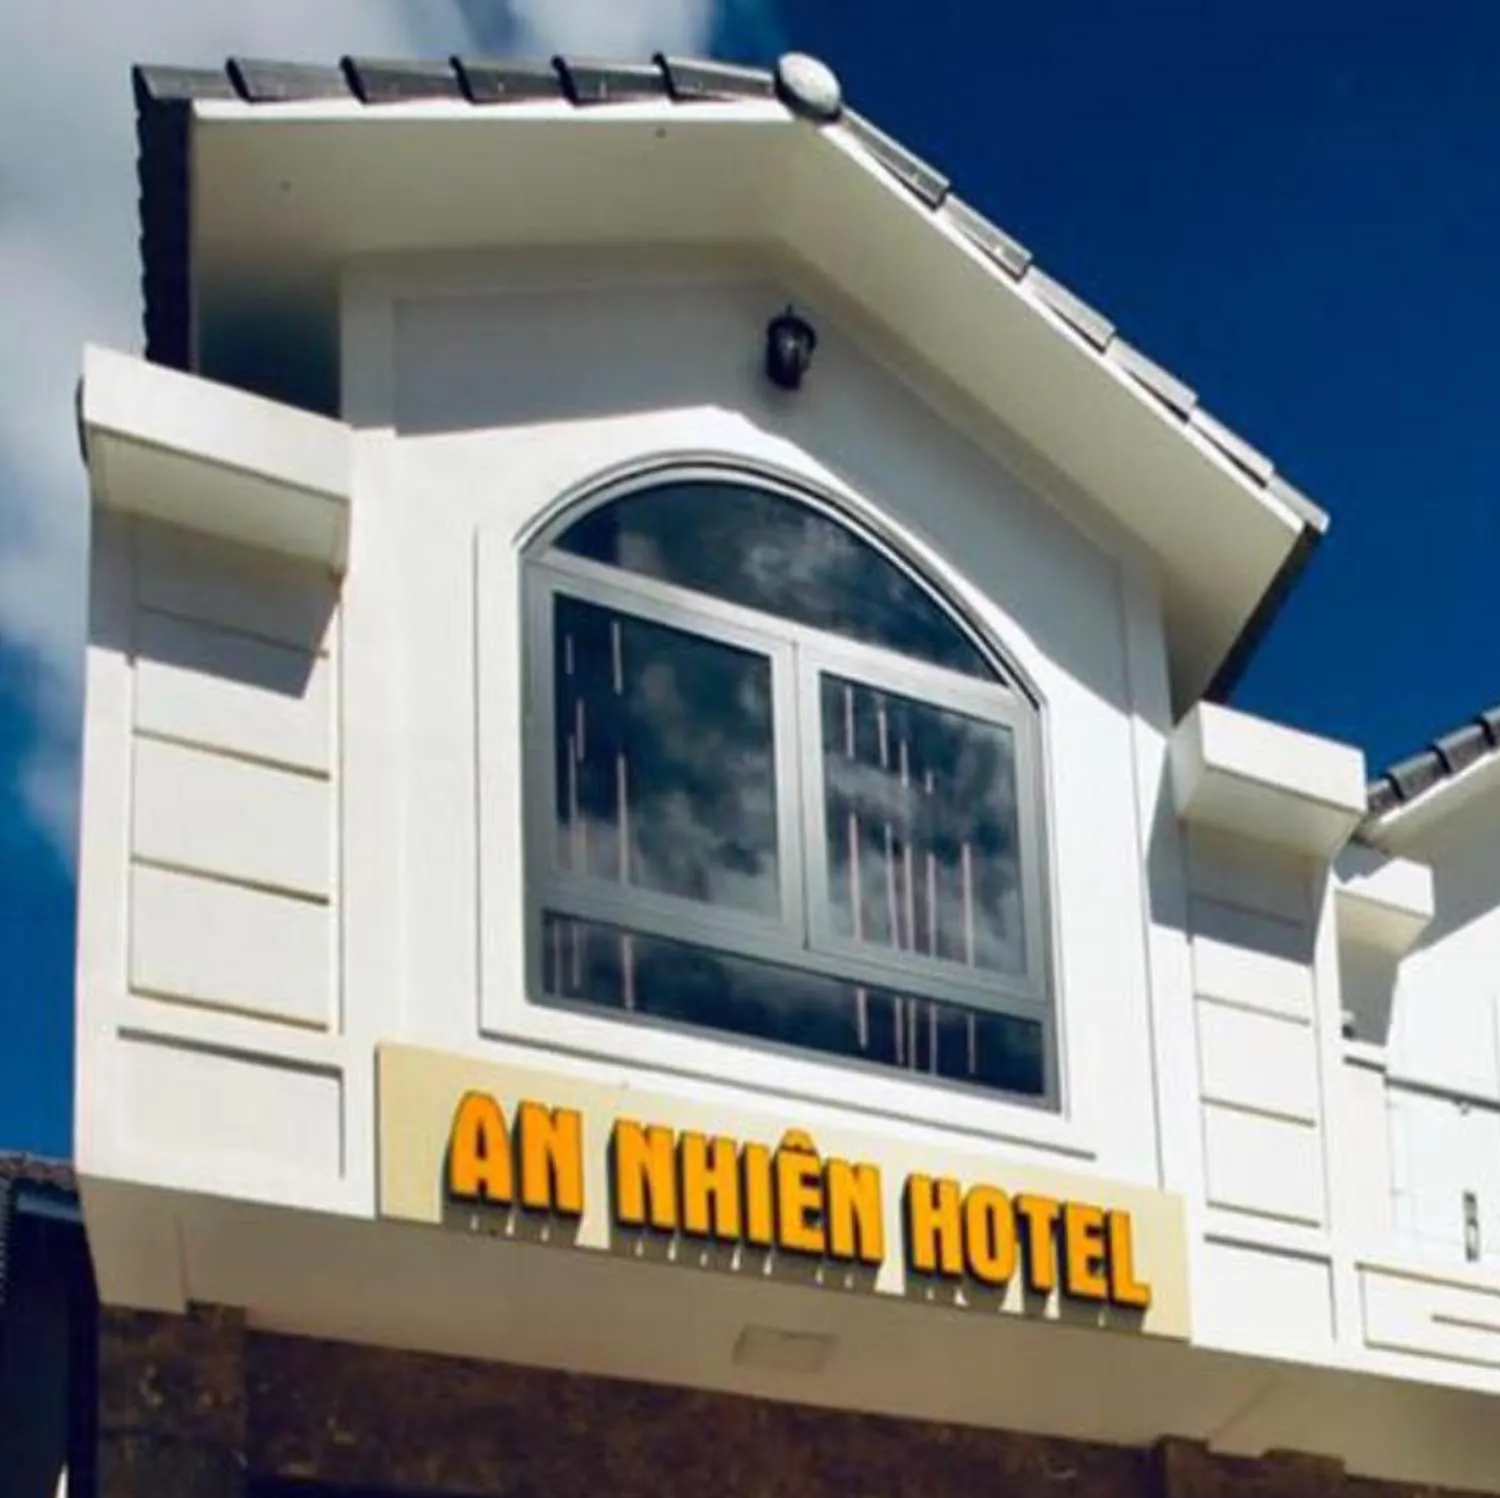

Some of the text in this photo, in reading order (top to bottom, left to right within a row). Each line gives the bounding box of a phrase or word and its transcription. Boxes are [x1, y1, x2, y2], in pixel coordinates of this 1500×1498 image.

[448, 1089, 1151, 1309] AN NHIÊN HOTEL
